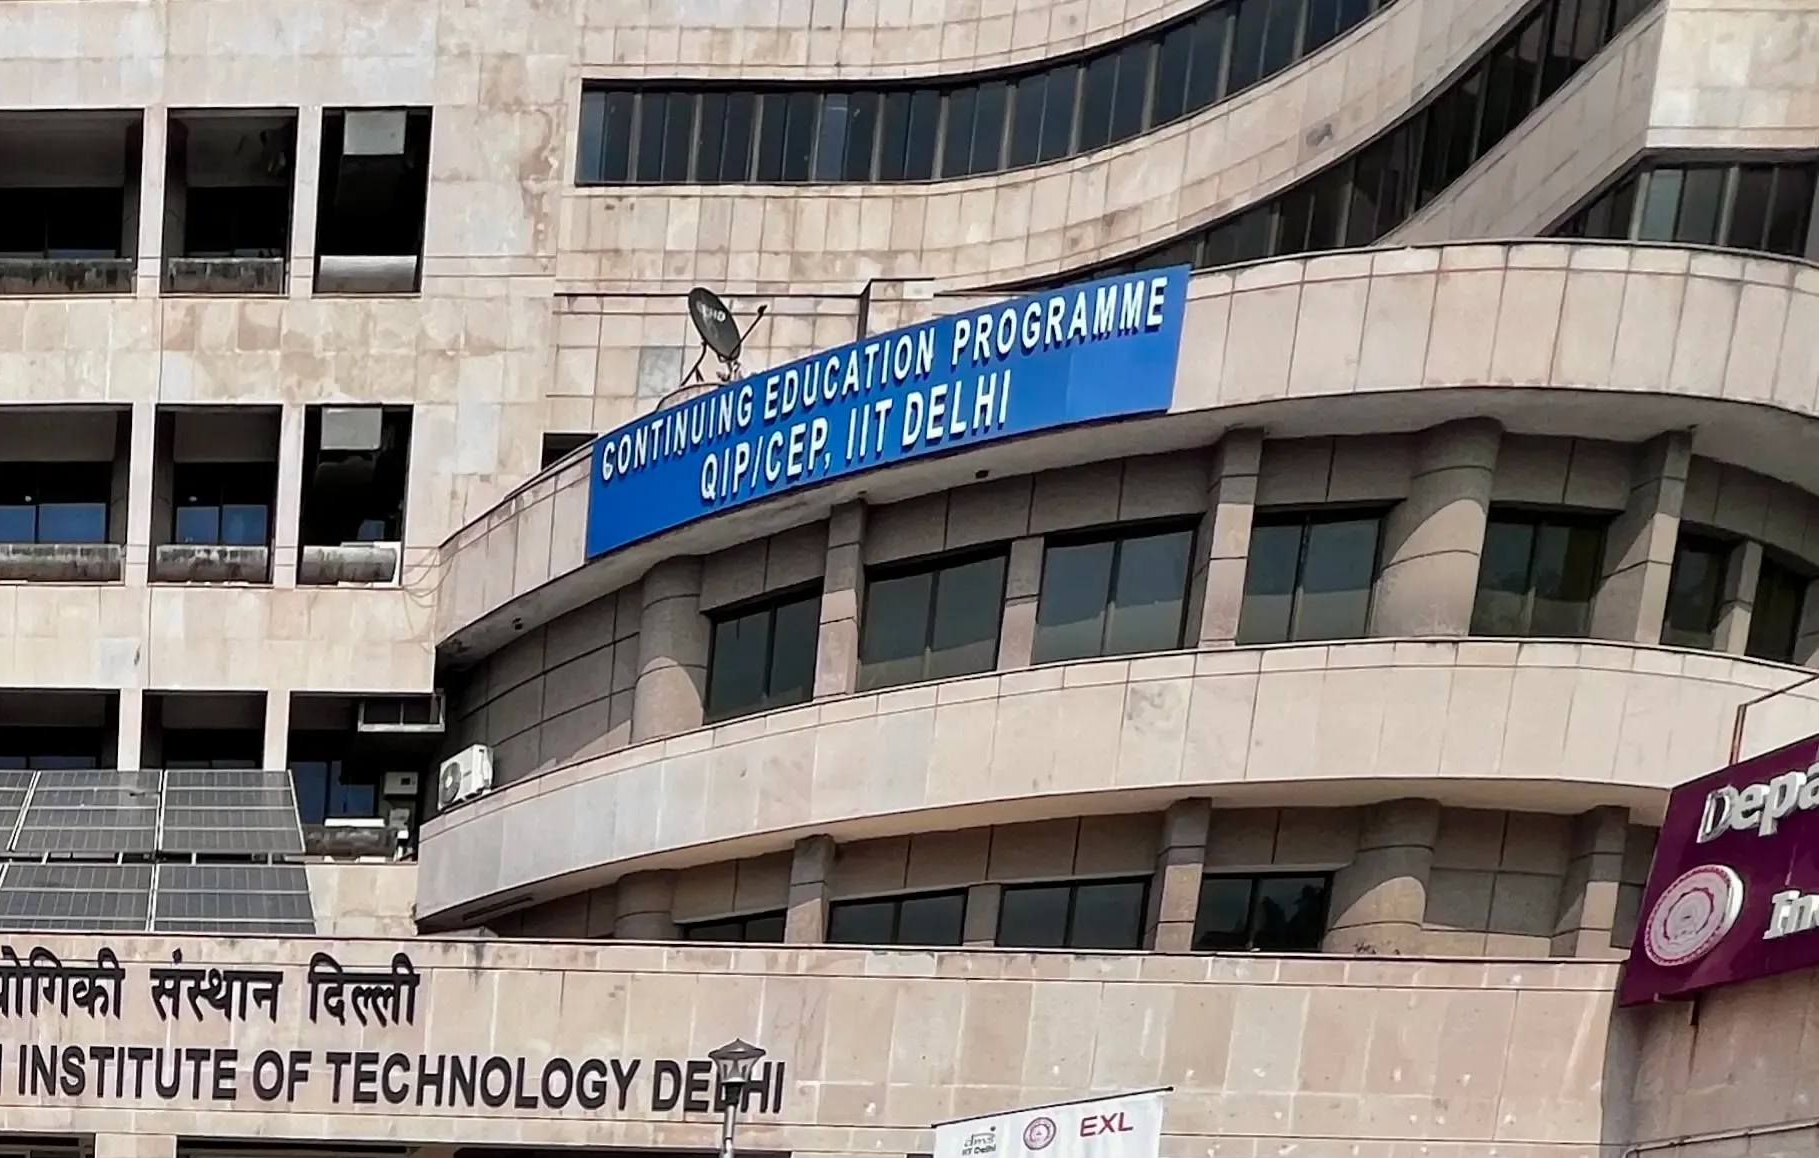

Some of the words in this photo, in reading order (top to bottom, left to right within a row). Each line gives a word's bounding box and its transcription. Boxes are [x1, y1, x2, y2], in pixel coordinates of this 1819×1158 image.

[601, 384, 754, 481] CONTINUING
[763, 325, 936, 421] EDUCATION
[950, 276, 1169, 367] PROGRAMME
[700, 416, 832, 501] QIP/CEP,
[845, 398, 894, 461] IIT
[901, 369, 1012, 447] DELHI
[149, 946, 285, 1023] संस्थान
[307, 951, 422, 1028] दिल्ली
[18, 1044, 239, 1102] INSTITUTE
[252, 1049, 312, 1103] OF
[325, 1050, 641, 1112] TECHNOLOGY
[651, 1059, 786, 1115] DELHI
[1079, 1111, 1134, 1138] EXL
